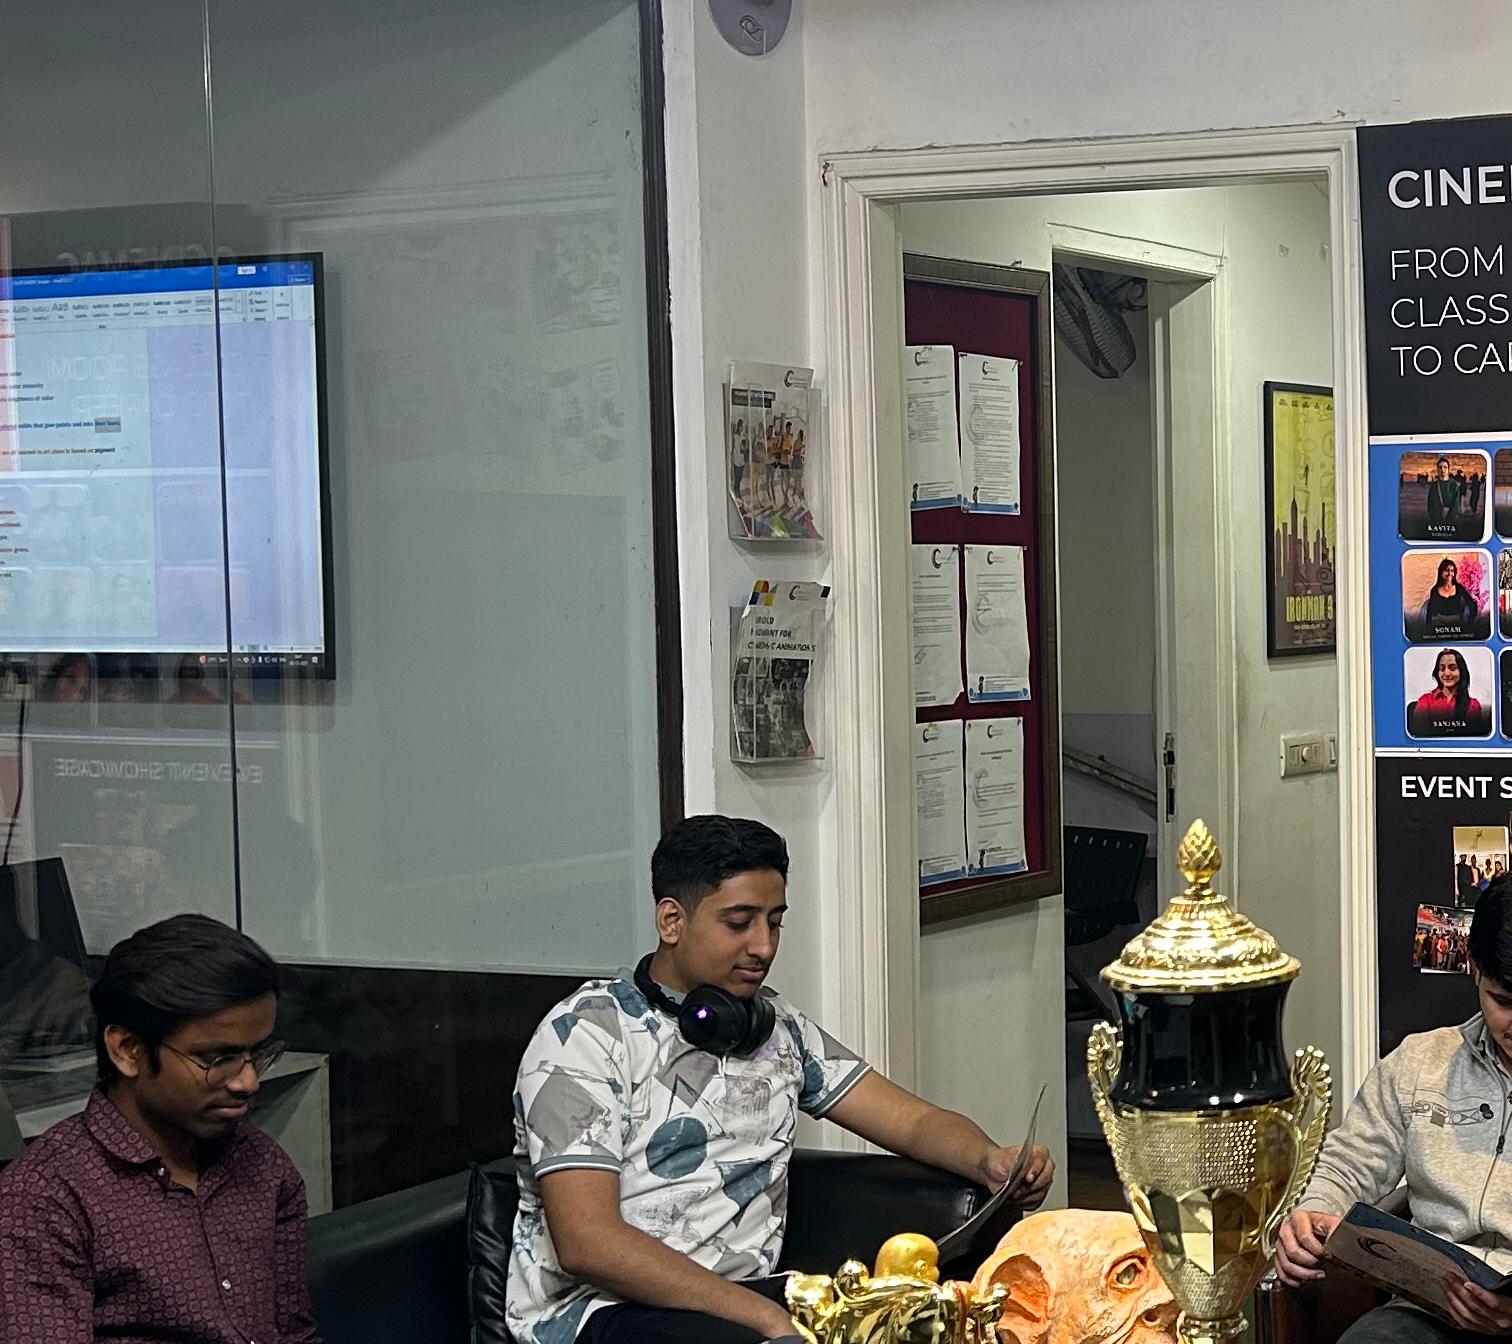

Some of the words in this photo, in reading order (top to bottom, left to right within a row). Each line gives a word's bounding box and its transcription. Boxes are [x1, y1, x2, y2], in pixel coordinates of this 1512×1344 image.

[1391, 244, 1503, 281] FROM
[1391, 293, 1510, 328] CLASS
[1390, 345, 1442, 377] TO
[1401, 775, 1492, 799] EVENT
